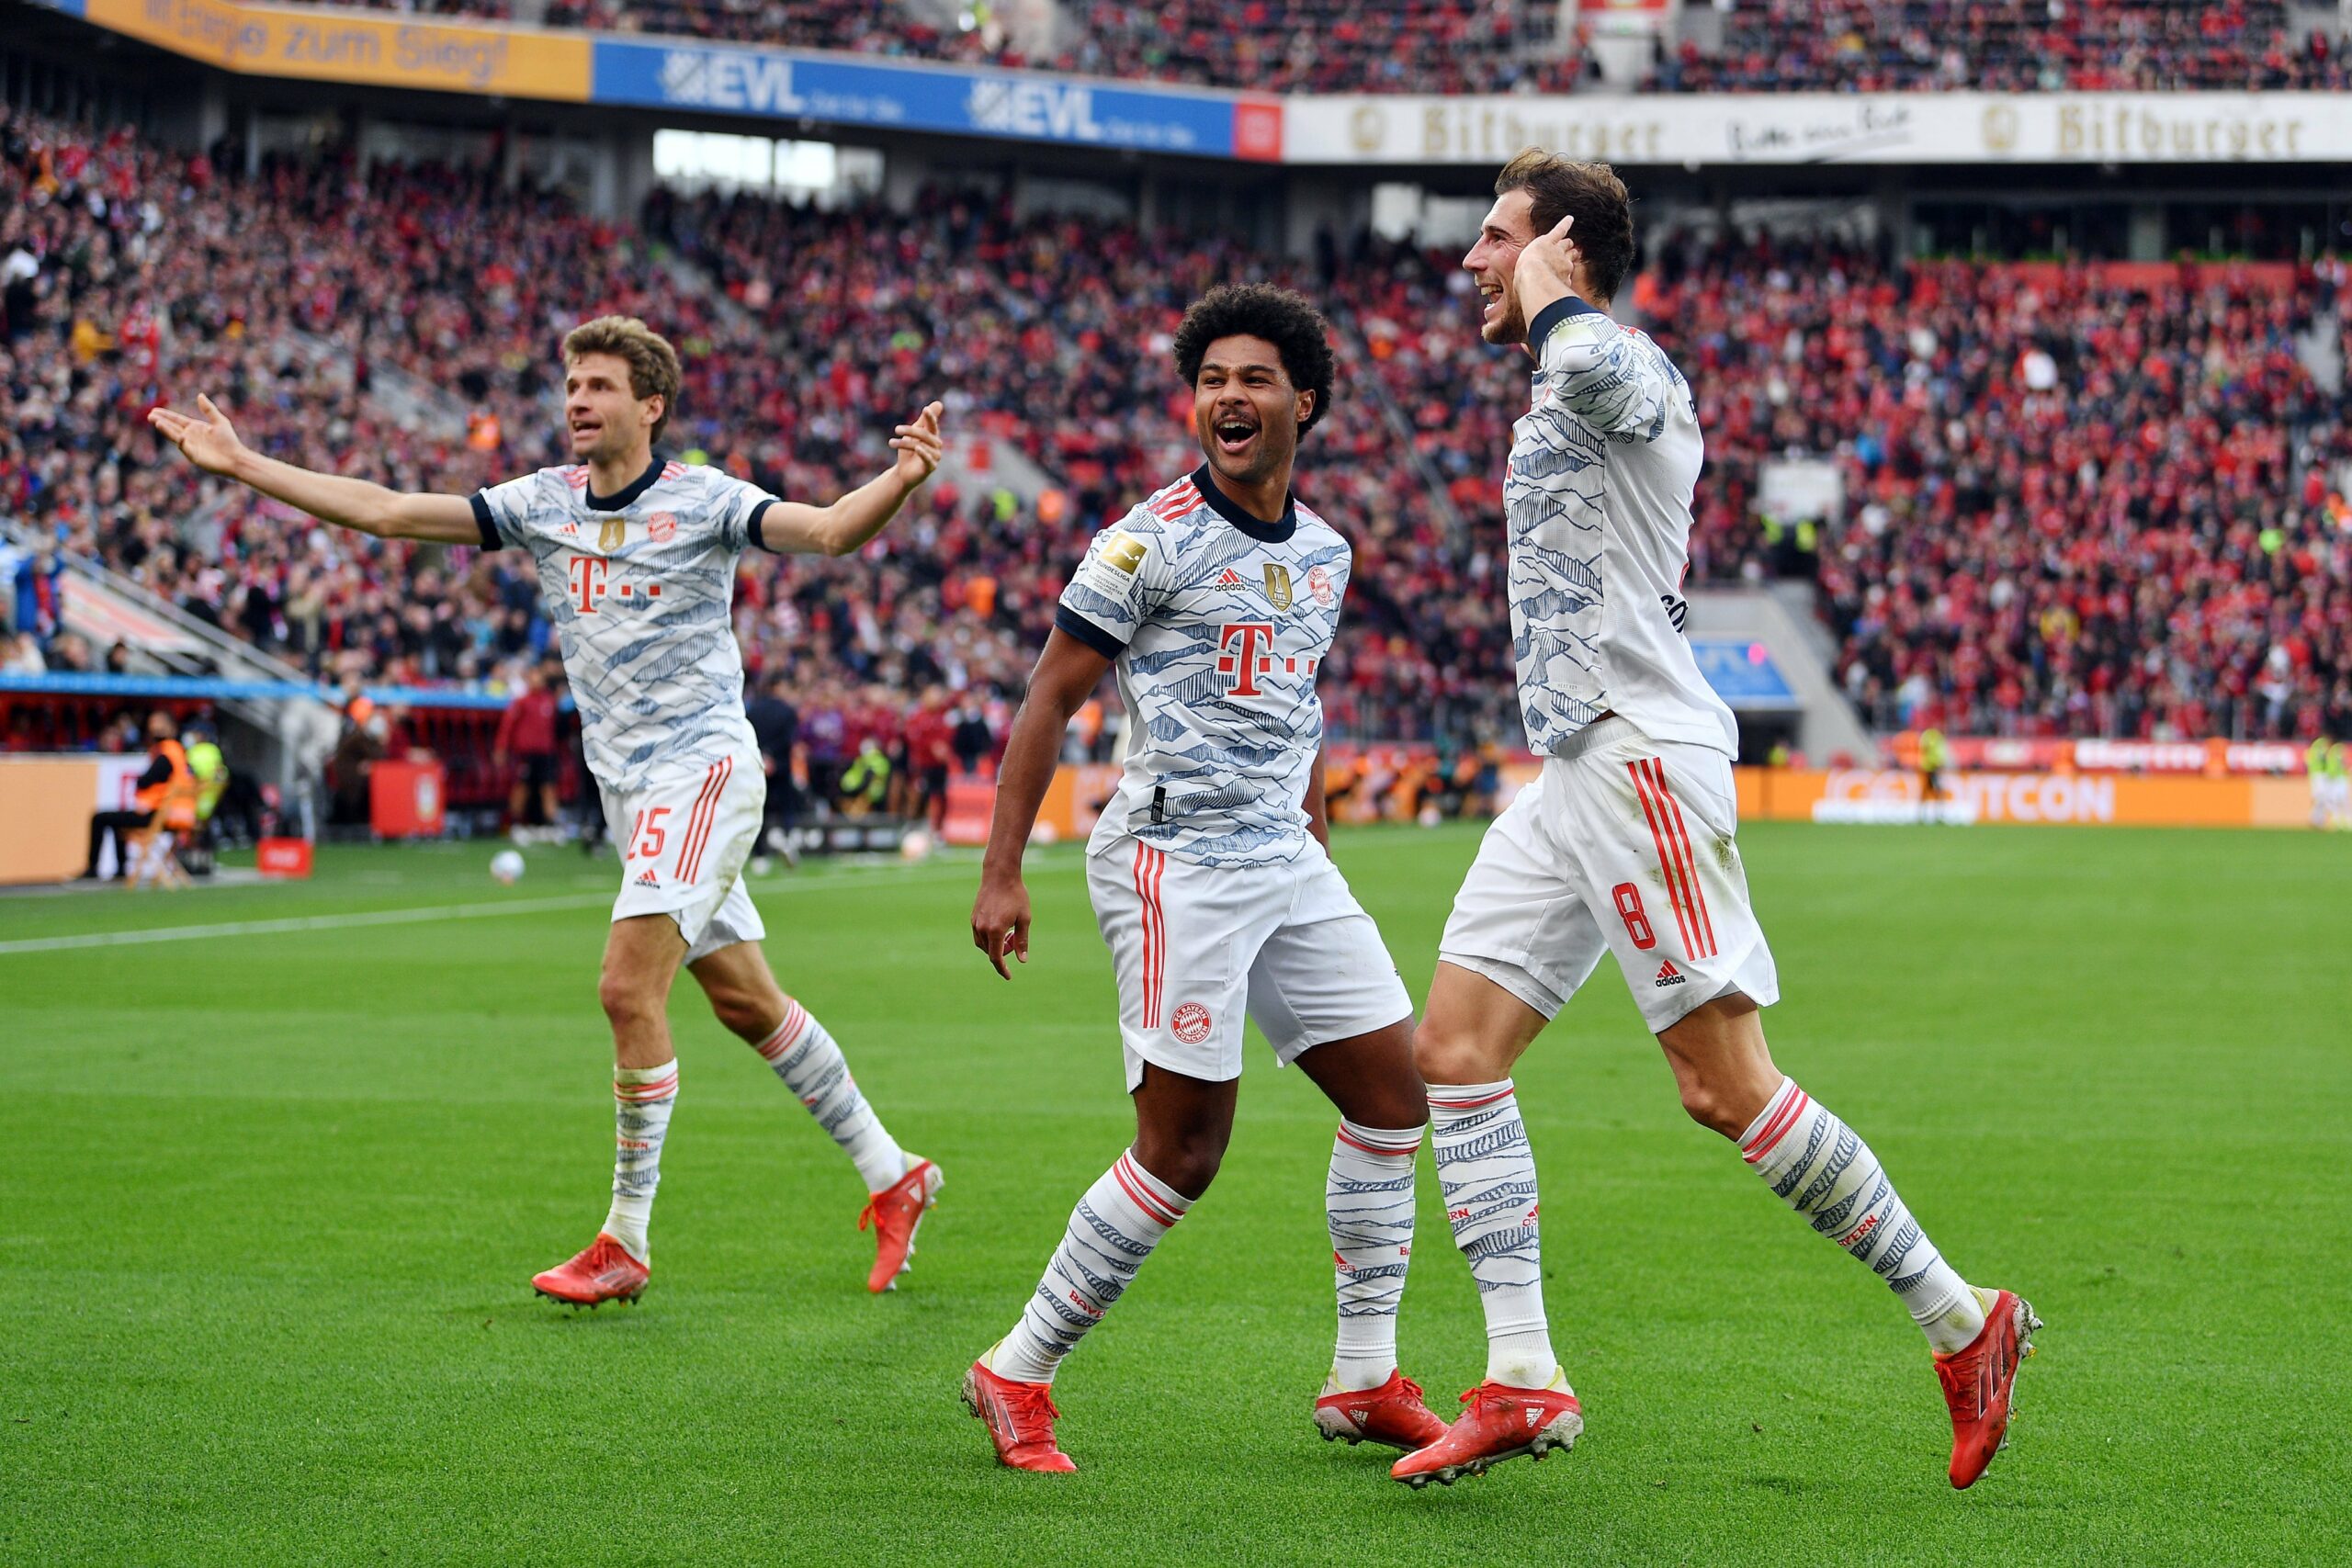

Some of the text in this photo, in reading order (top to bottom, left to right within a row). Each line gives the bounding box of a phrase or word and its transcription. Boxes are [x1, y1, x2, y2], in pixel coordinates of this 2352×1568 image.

[707, 53, 805, 114] EVL
[1010, 81, 1102, 141] EVL
[1421, 94, 1667, 159] Bitburger
[2055, 94, 2304, 160] Bitburger
[1096, 559, 1130, 582] BUNDESLIGA
[1215, 582, 1246, 592] adidas
[1611, 882, 1657, 950] 8
[1655, 974, 1687, 987] adidas
[1181, 1005, 1207, 1020] BAYERN
